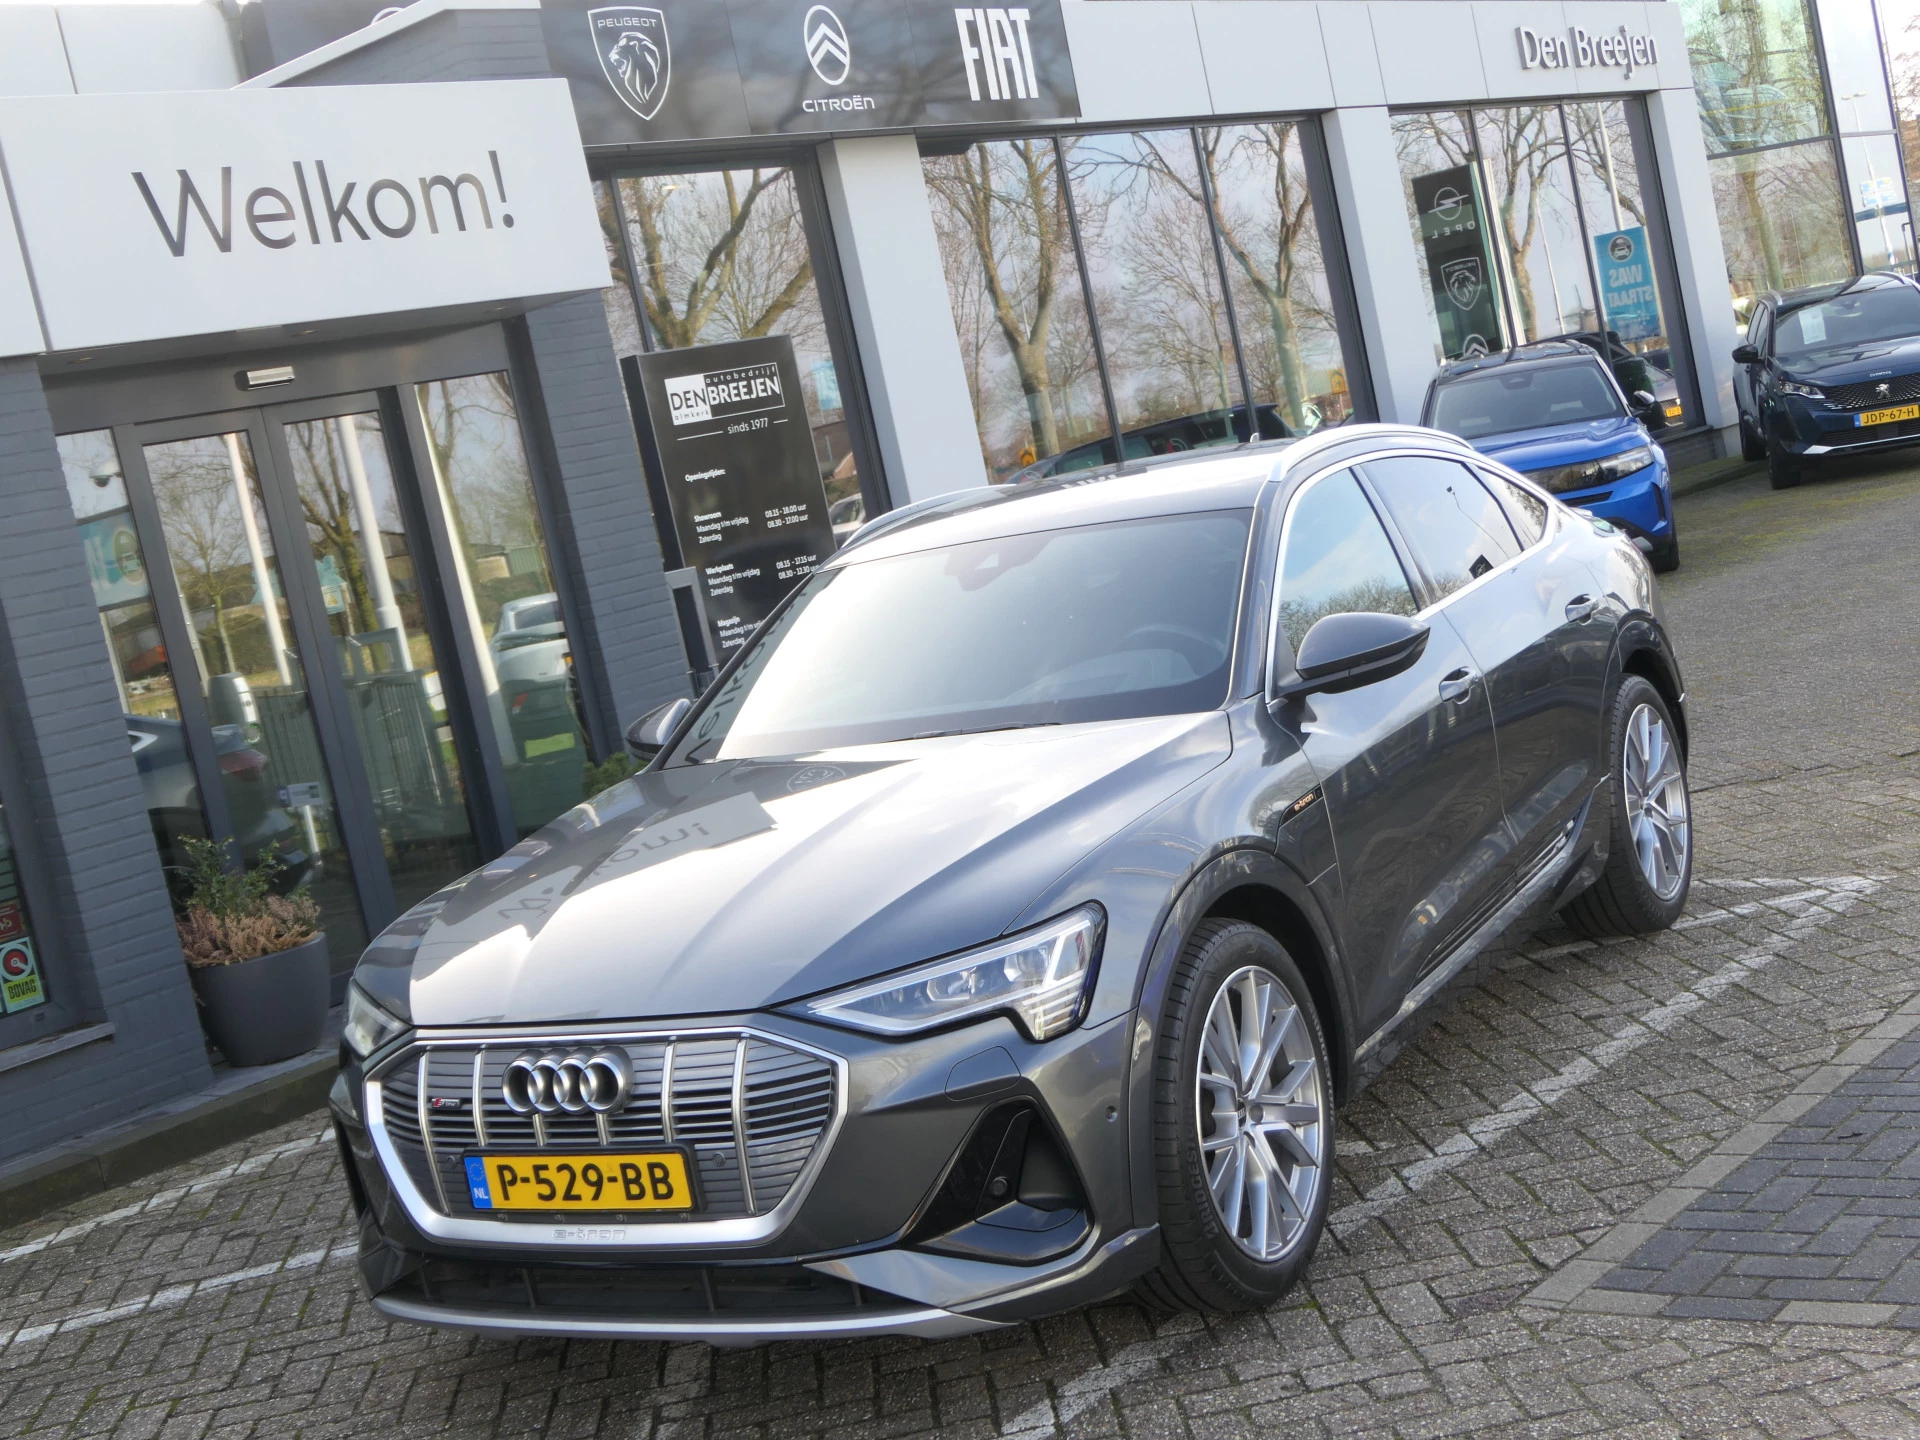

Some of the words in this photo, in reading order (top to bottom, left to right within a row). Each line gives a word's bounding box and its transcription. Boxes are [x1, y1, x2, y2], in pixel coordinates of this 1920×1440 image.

[597, 17, 657, 29] PEUGEOT
[954, 8, 1040, 101] FIAT
[1514, 26, 1571, 70] Den
[1568, 24, 1660, 80] Breejen
[131, 149, 515, 257] Welkom!
[705, 365, 776, 384] autobedrijf
[670, 388, 708, 411] DEN
[707, 376, 781, 405] BREEJEN
[1864, 407, 1915, 424] JDP-67-H
[727, 421, 750, 434] sinds
[751, 417, 769, 430] 1977
[694, 511, 722, 522] Showroom
[696, 522, 721, 533] Maandag
[730, 516, 749, 526] vrijdag
[797, 503, 807, 511] uur
[698, 533, 722, 543] Zaterdag
[705, 563, 734, 575] Werkplaats
[708, 575, 733, 585] Maandag
[742, 568, 760, 578] vrijdag
[807, 554, 817, 562] uur
[710, 585, 734, 596] Zaterdag
[720, 626, 745, 637] Maandag
[496, 1161, 675, 1202] P-529-BB
[474, 1187, 489, 1200] NL
